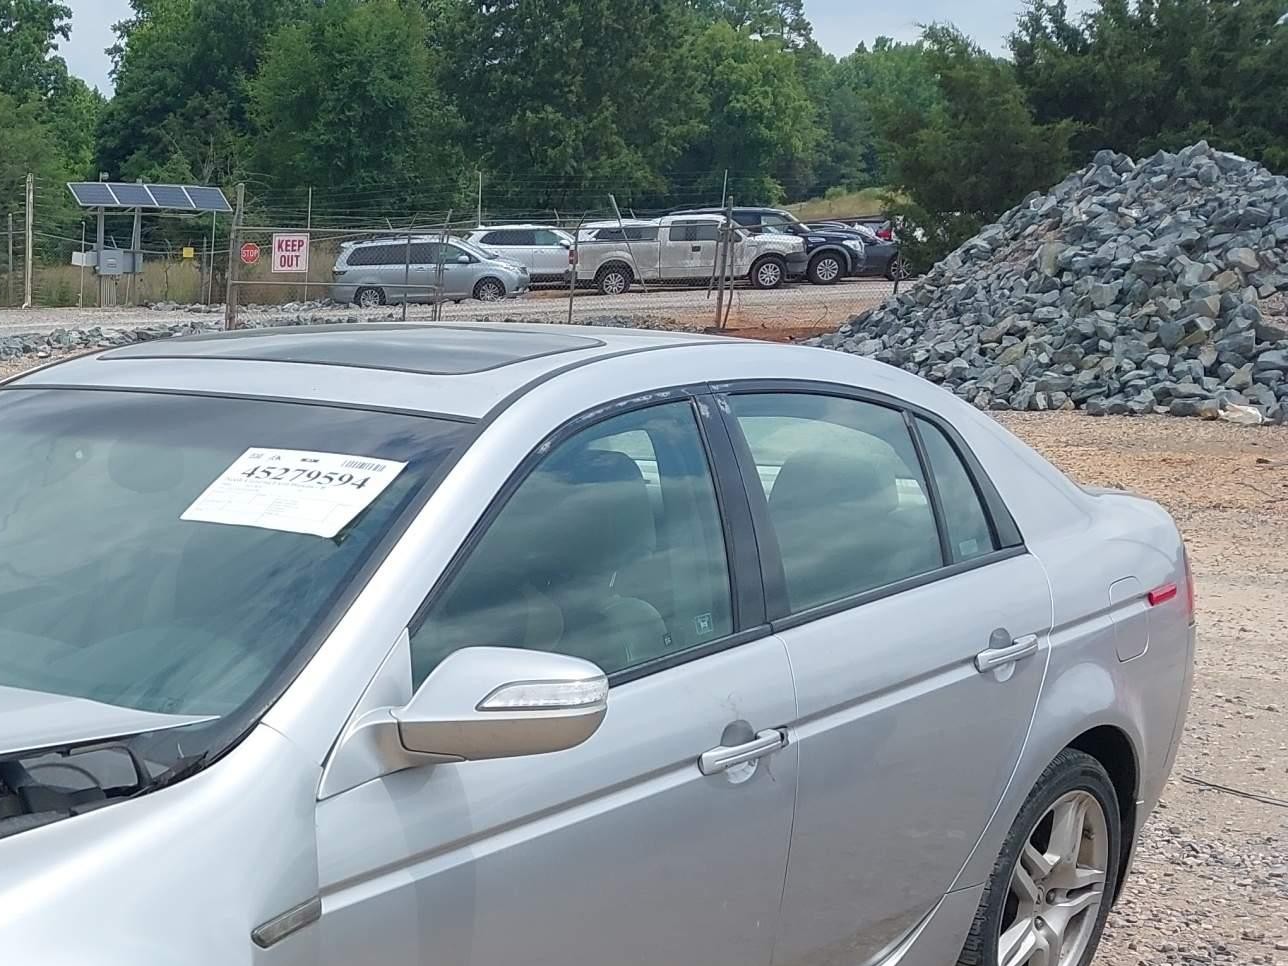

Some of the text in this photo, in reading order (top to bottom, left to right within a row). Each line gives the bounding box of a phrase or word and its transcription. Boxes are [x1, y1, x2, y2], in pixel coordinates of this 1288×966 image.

[277, 239, 304, 253] KEEP
[242, 249, 259, 258] STOP
[280, 255, 300, 268] OUT
[241, 465, 371, 490] 45279594
